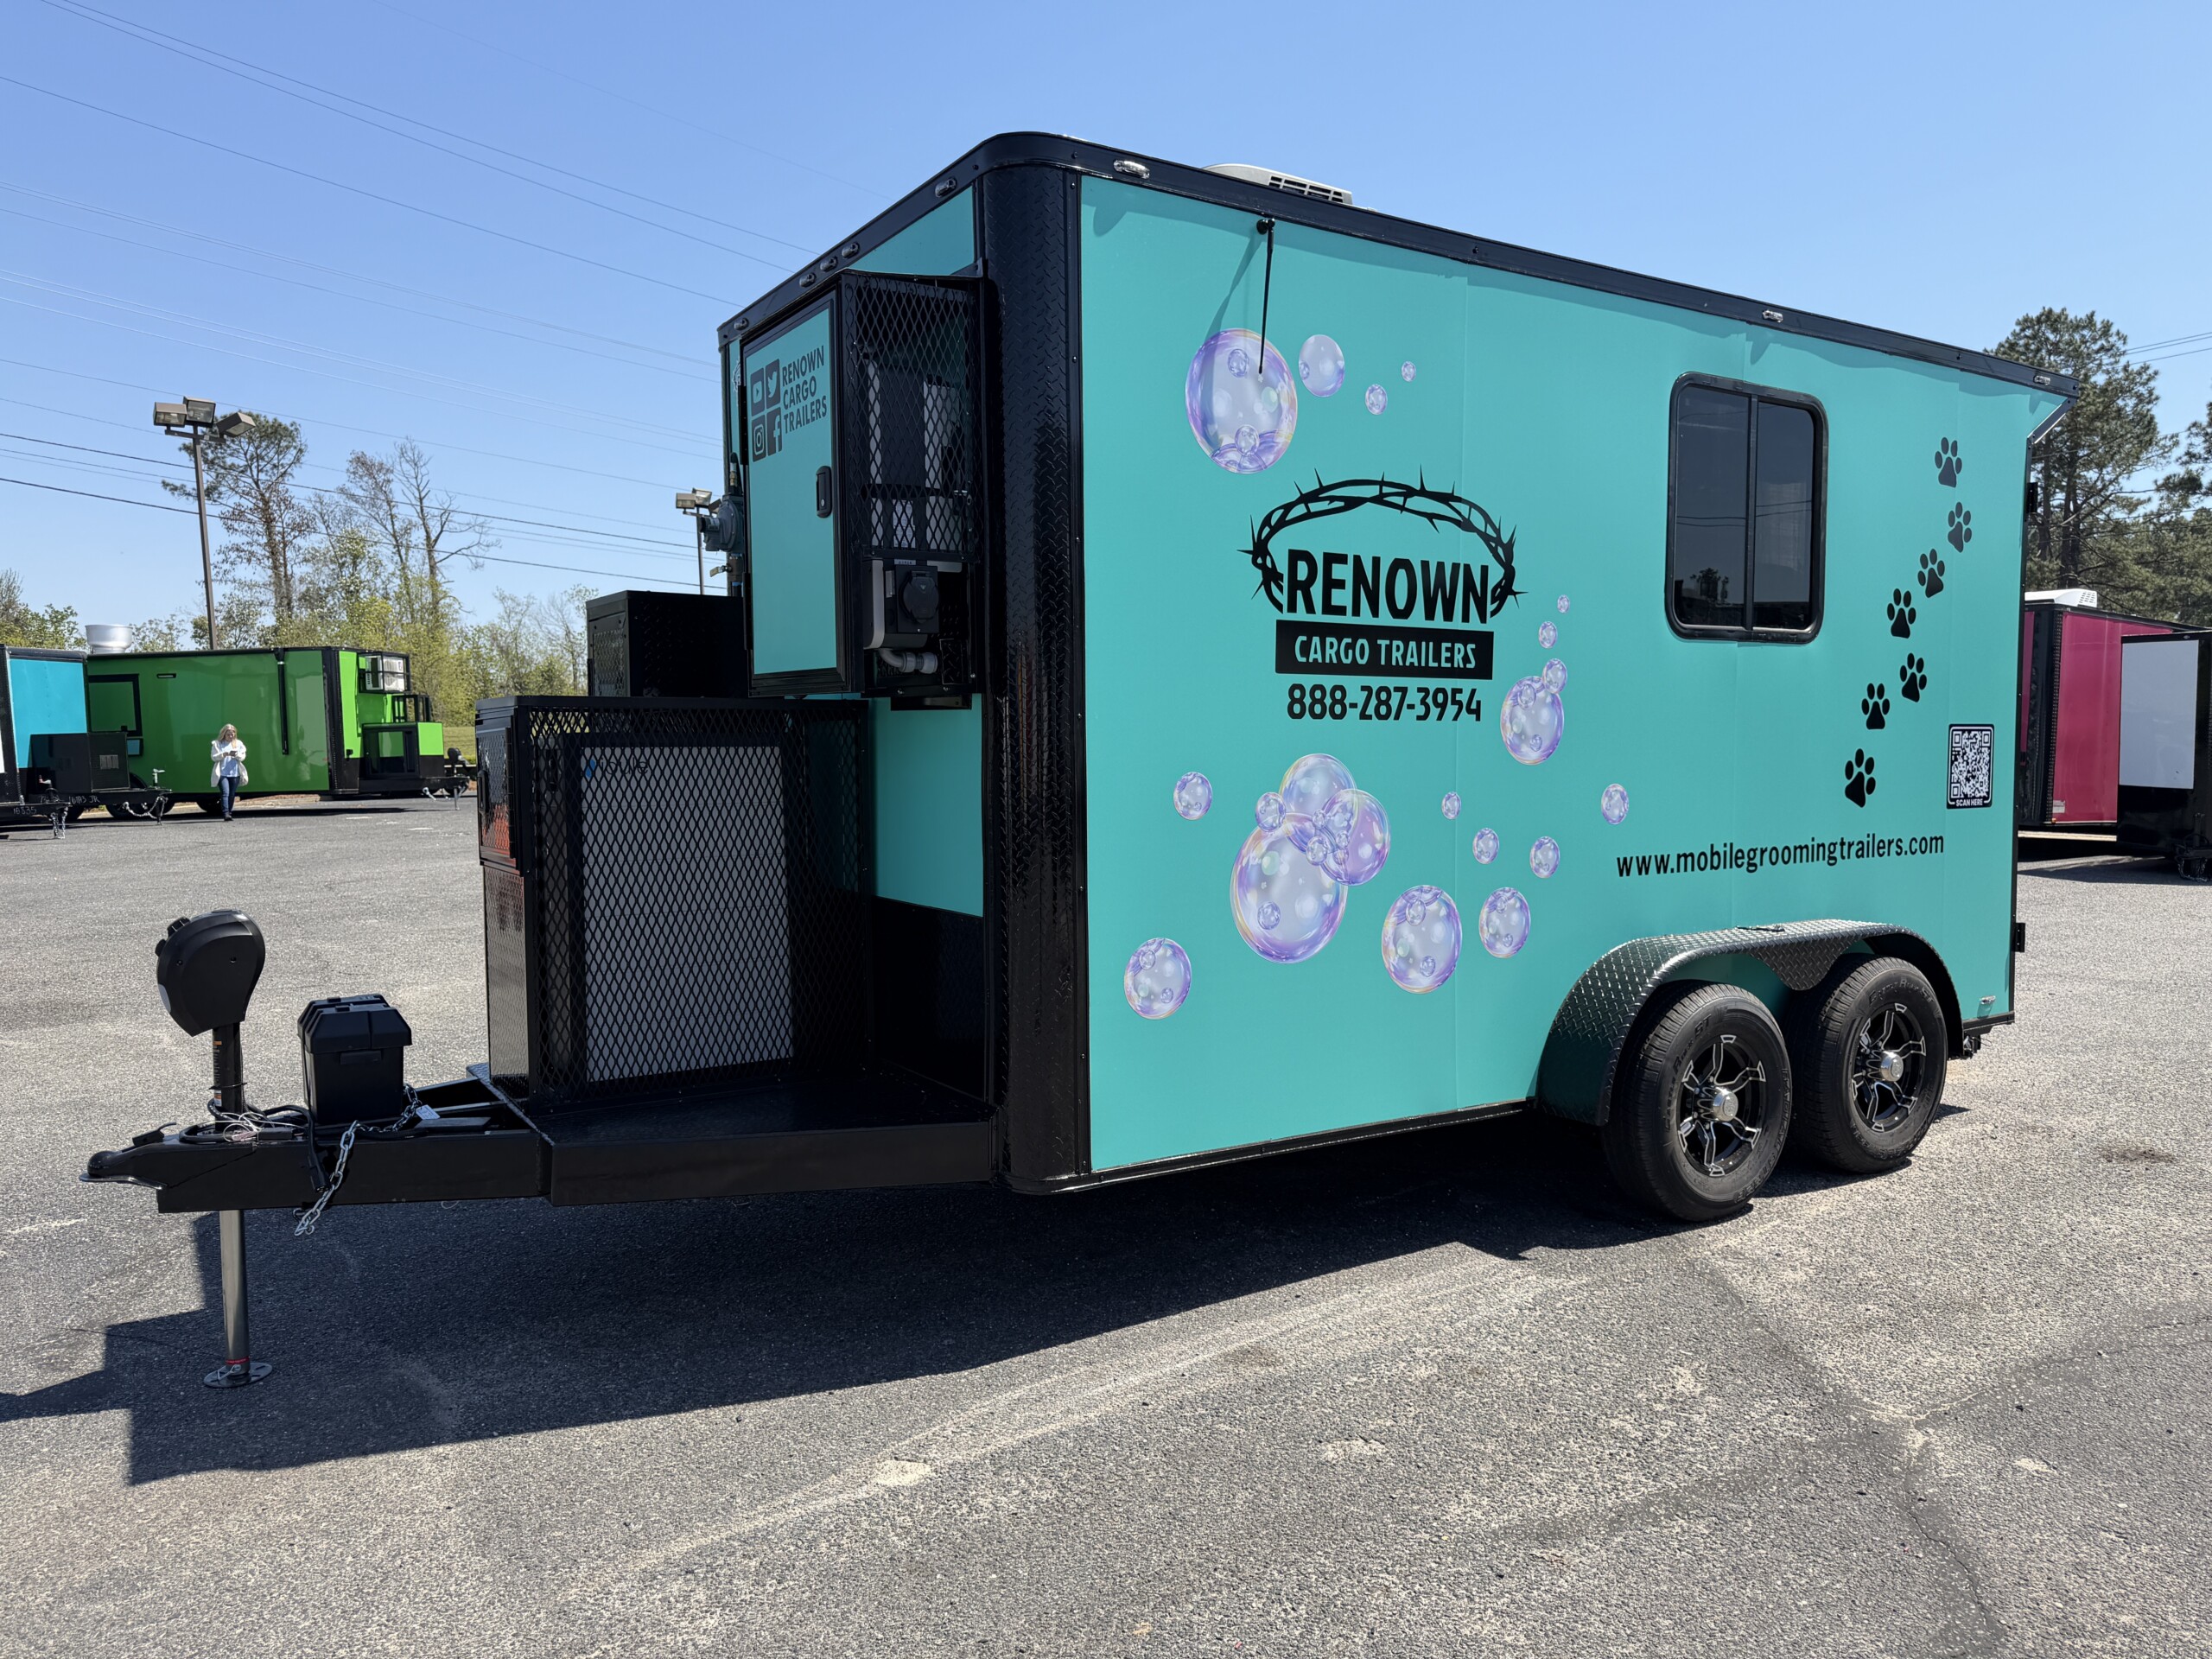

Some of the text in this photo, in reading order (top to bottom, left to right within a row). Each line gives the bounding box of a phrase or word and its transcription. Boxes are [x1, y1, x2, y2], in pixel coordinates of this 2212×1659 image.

[782, 346, 824, 387] RENOWN
[783, 375, 817, 410] CARGO
[784, 395, 827, 434] TRAILERS
[1287, 549, 1489, 624] RENOWN
[1294, 635, 1476, 669] CARGO TRAILERS
[1287, 683, 1481, 721] 888-287-3954
[1955, 798, 1971, 807] SCAN
[1617, 833, 1944, 877] www.mobilegroomingtrailers.com
